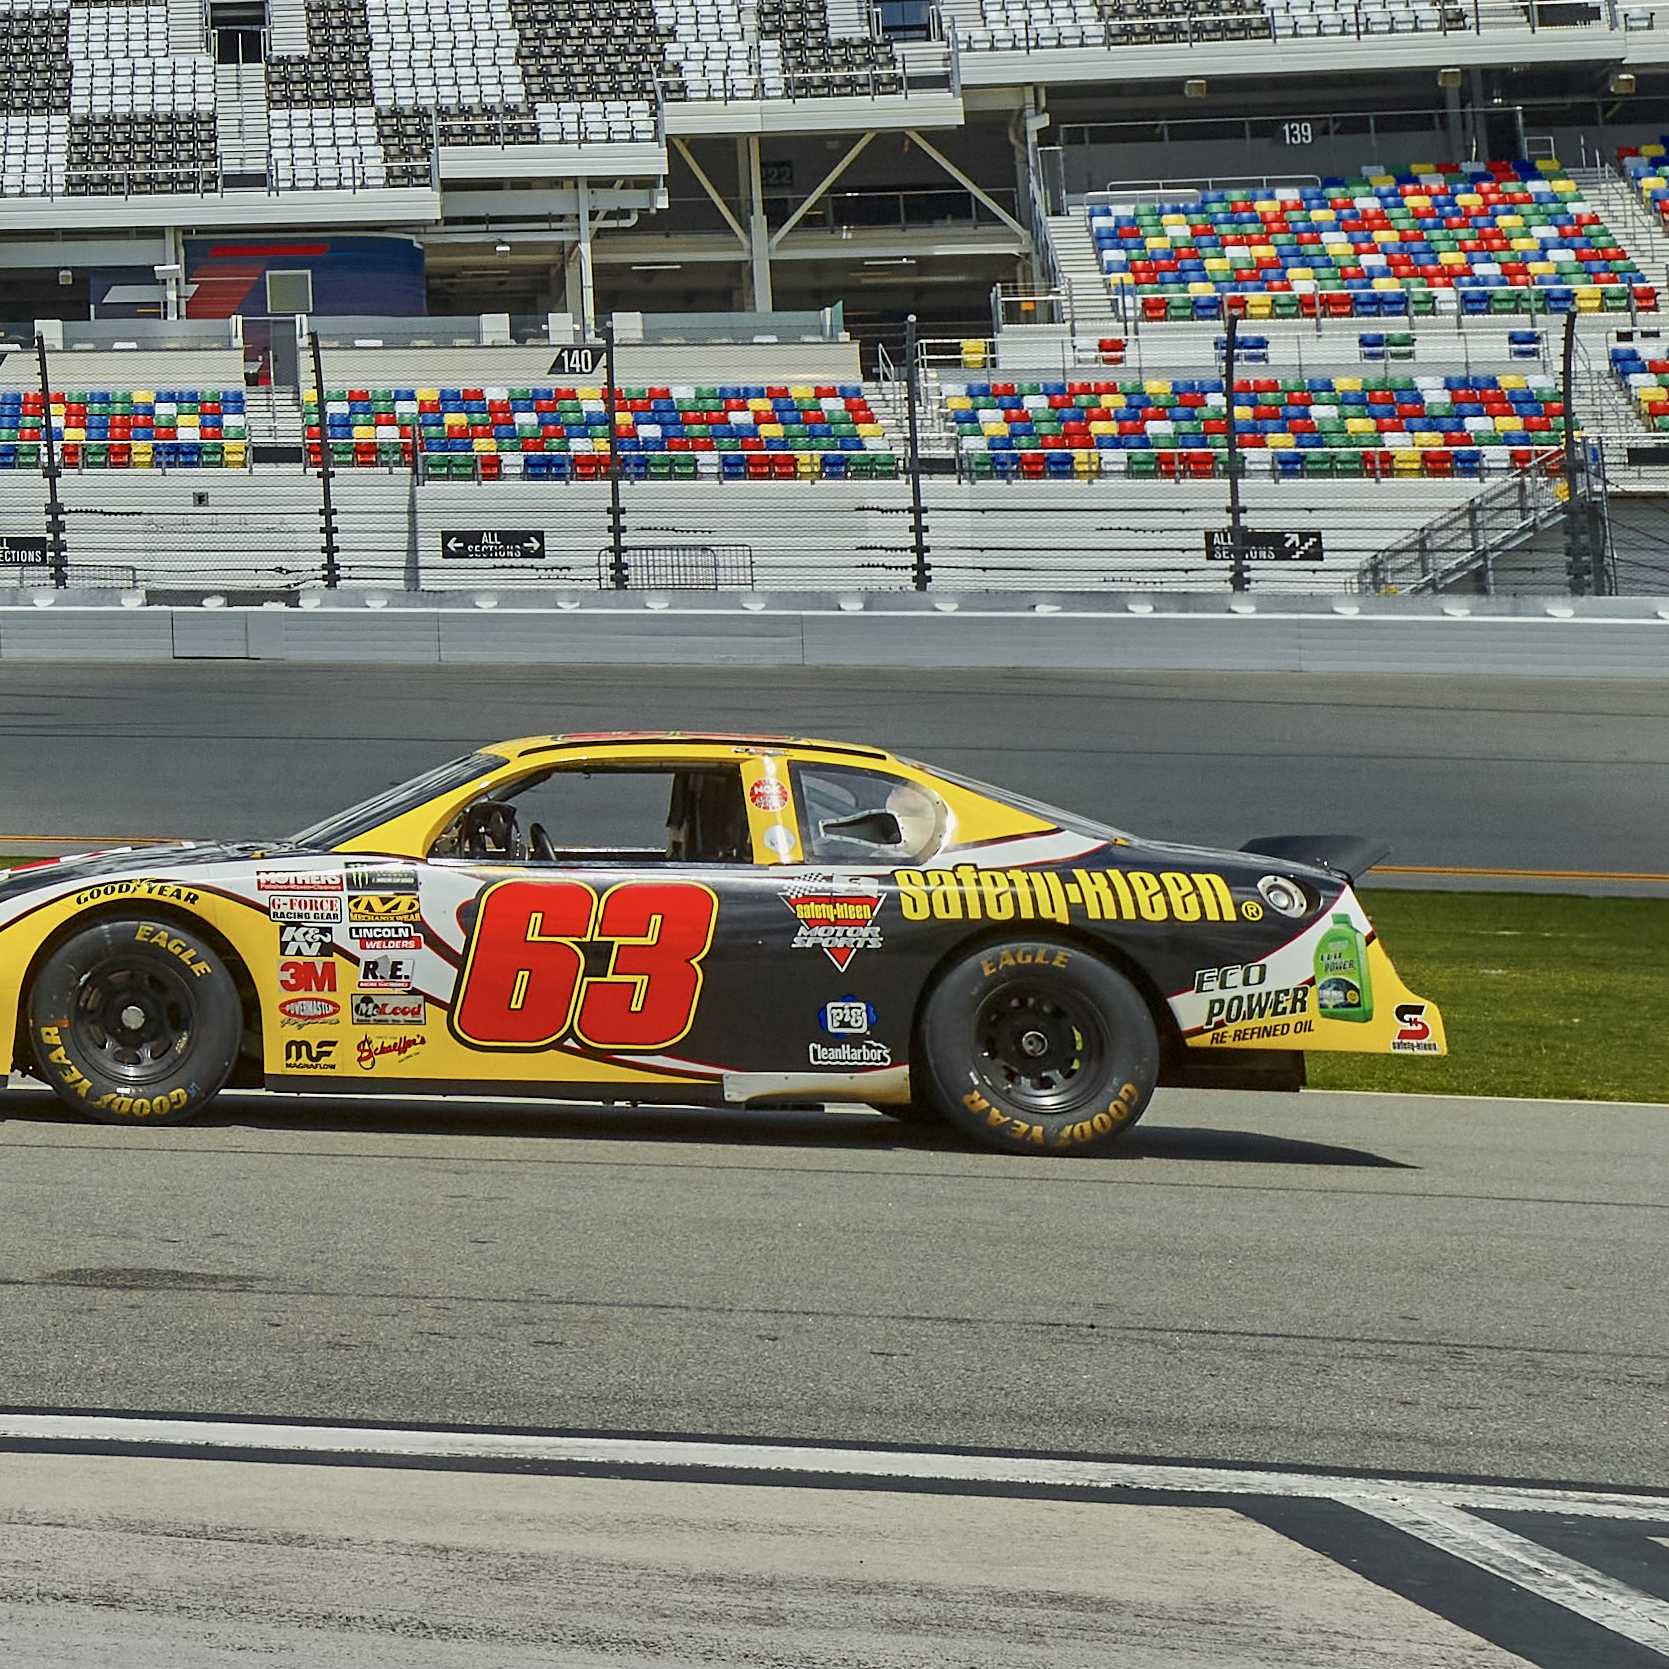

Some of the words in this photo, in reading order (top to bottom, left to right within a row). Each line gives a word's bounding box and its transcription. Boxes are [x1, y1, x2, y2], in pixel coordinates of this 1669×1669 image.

[1282, 122, 1313, 144] 139
[560, 348, 592, 373] 140
[481, 532, 501, 544] ALL
[1213, 532, 1234, 546] ALL
[467, 544, 521, 557] SECTIONS
[754, 784, 781, 795] NGK
[258, 872, 341, 885] MOTHERS
[75, 879, 200, 906] GOODYEAR
[895, 863, 1238, 925] safety-kleen
[272, 898, 338, 911] G-FORCE
[272, 911, 311, 920] RACING
[313, 912, 339, 921] GEAR
[349, 913, 394, 922] MECHANIX
[396, 913, 421, 922] WEAR
[351, 927, 409, 938] LINCOLN
[797, 925, 882, 937] MOTOR
[365, 939, 416, 949] WELDERS
[790, 936, 884, 949] SPORTS
[133, 924, 212, 978] EAGLE
[453, 878, 719, 1050] 63
[981, 948, 1073, 977] EAGLE
[1324, 959, 1355, 973] POWER
[279, 961, 337, 992] 3M
[1194, 963, 1267, 994] ECO
[285, 1000, 334, 1016] POWERMASTER
[358, 1002, 422, 1018] McLeod
[1204, 985, 1311, 1029] POWER
[1209, 1022, 1291, 1046] RE-REFINED
[1293, 1019, 1315, 1034] OIL
[356, 1033, 427, 1064] Schaeffer's
[809, 1041, 892, 1065] CleanHarbors
[40, 1025, 189, 1118] GOODYEAR
[285, 1062, 337, 1070] MAGNAFLOW
[962, 1083, 1139, 1148] GOODYEAR
